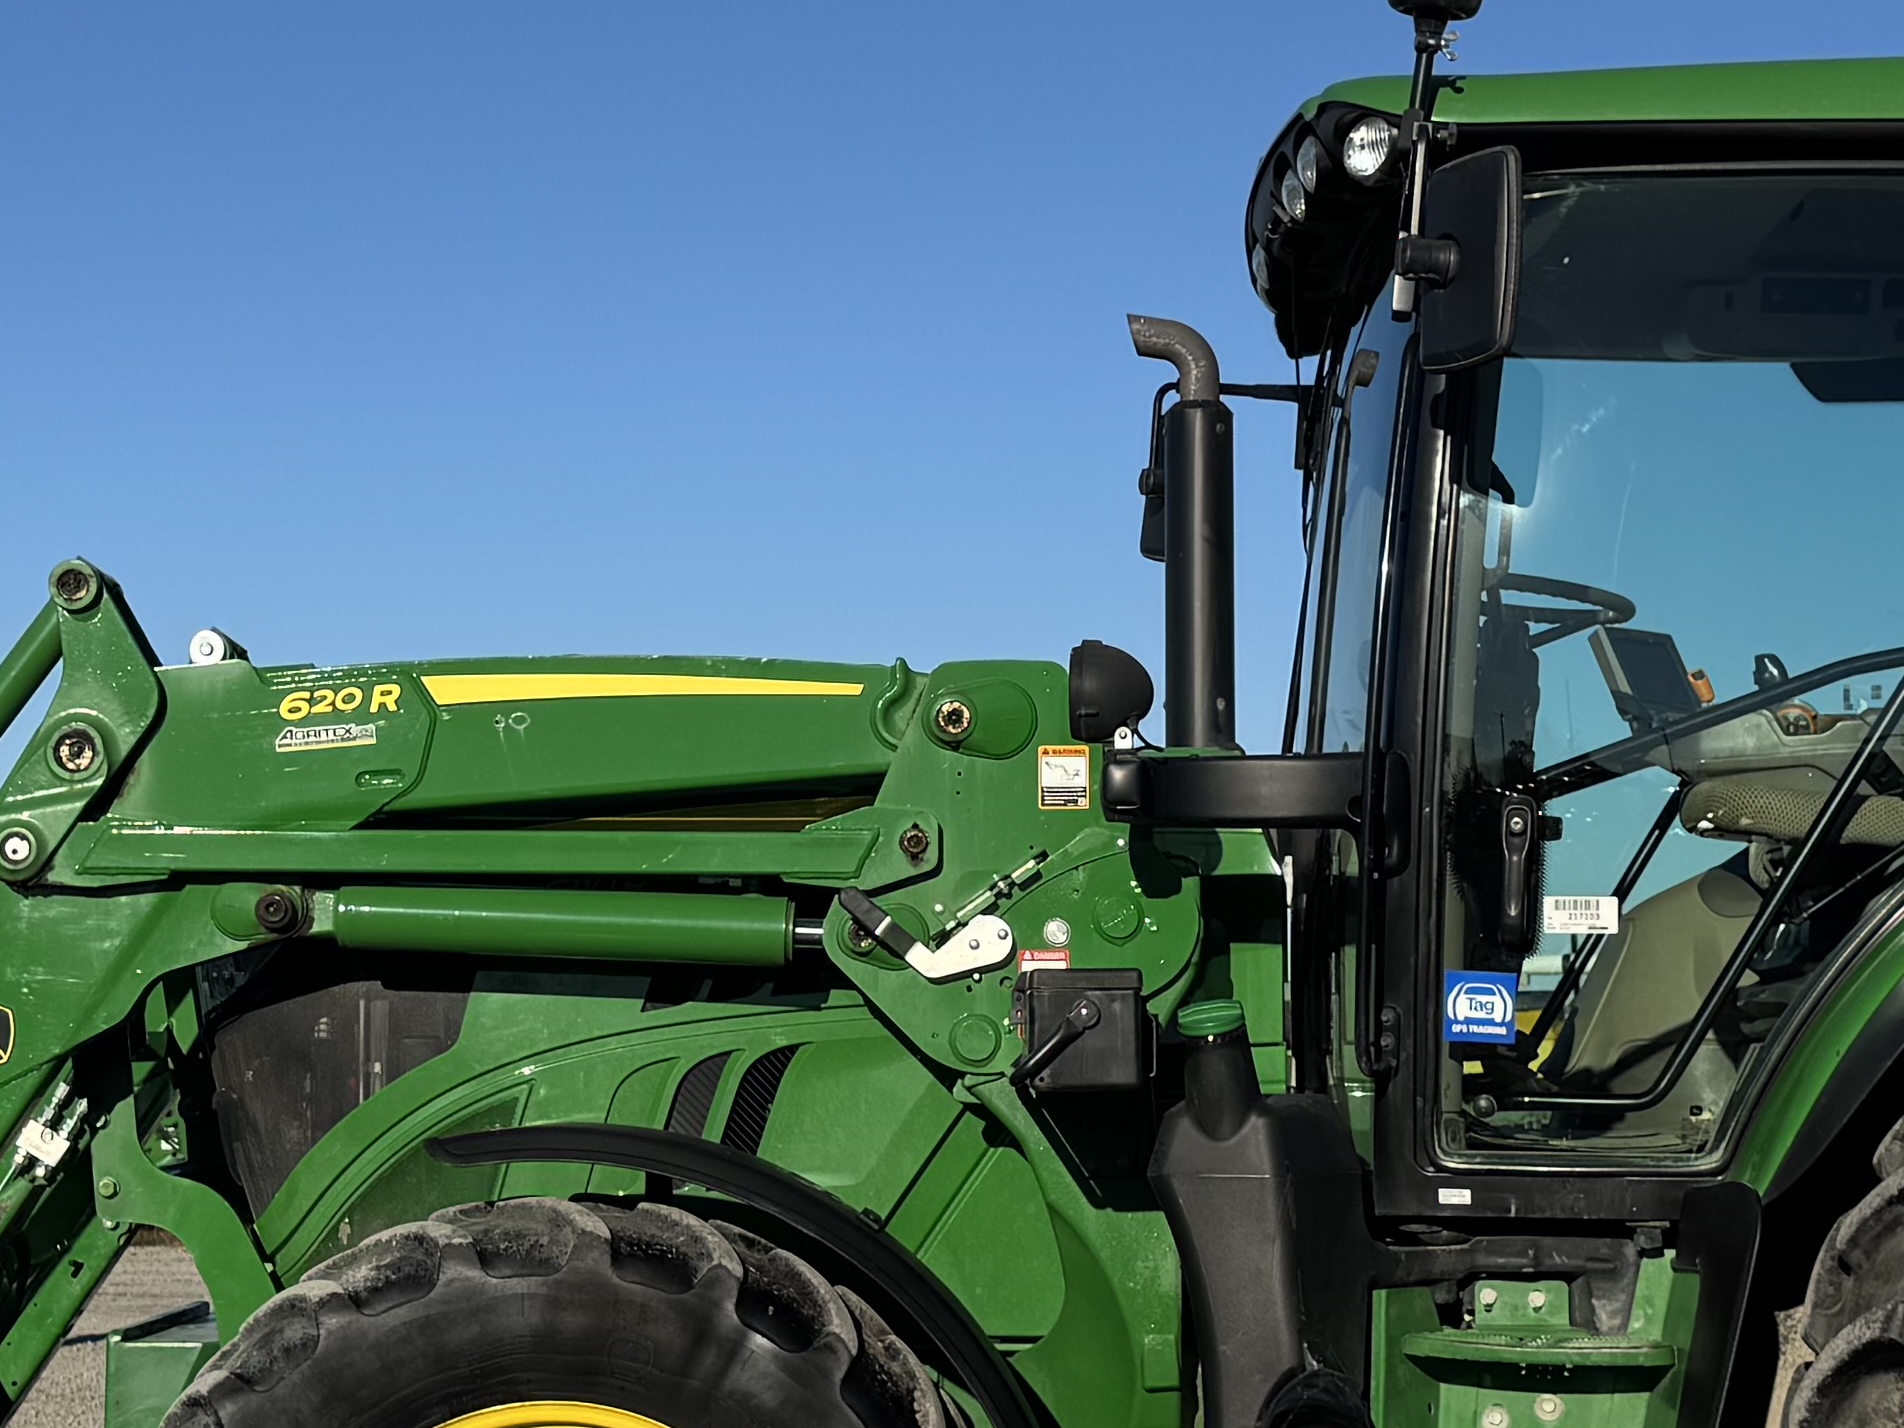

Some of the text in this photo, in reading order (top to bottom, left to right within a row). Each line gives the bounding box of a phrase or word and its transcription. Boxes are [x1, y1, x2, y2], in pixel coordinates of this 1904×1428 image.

[279, 683, 402, 721] 620 R
[279, 726, 353, 741] AGRITEX
[1465, 996, 1495, 1015] Tag
